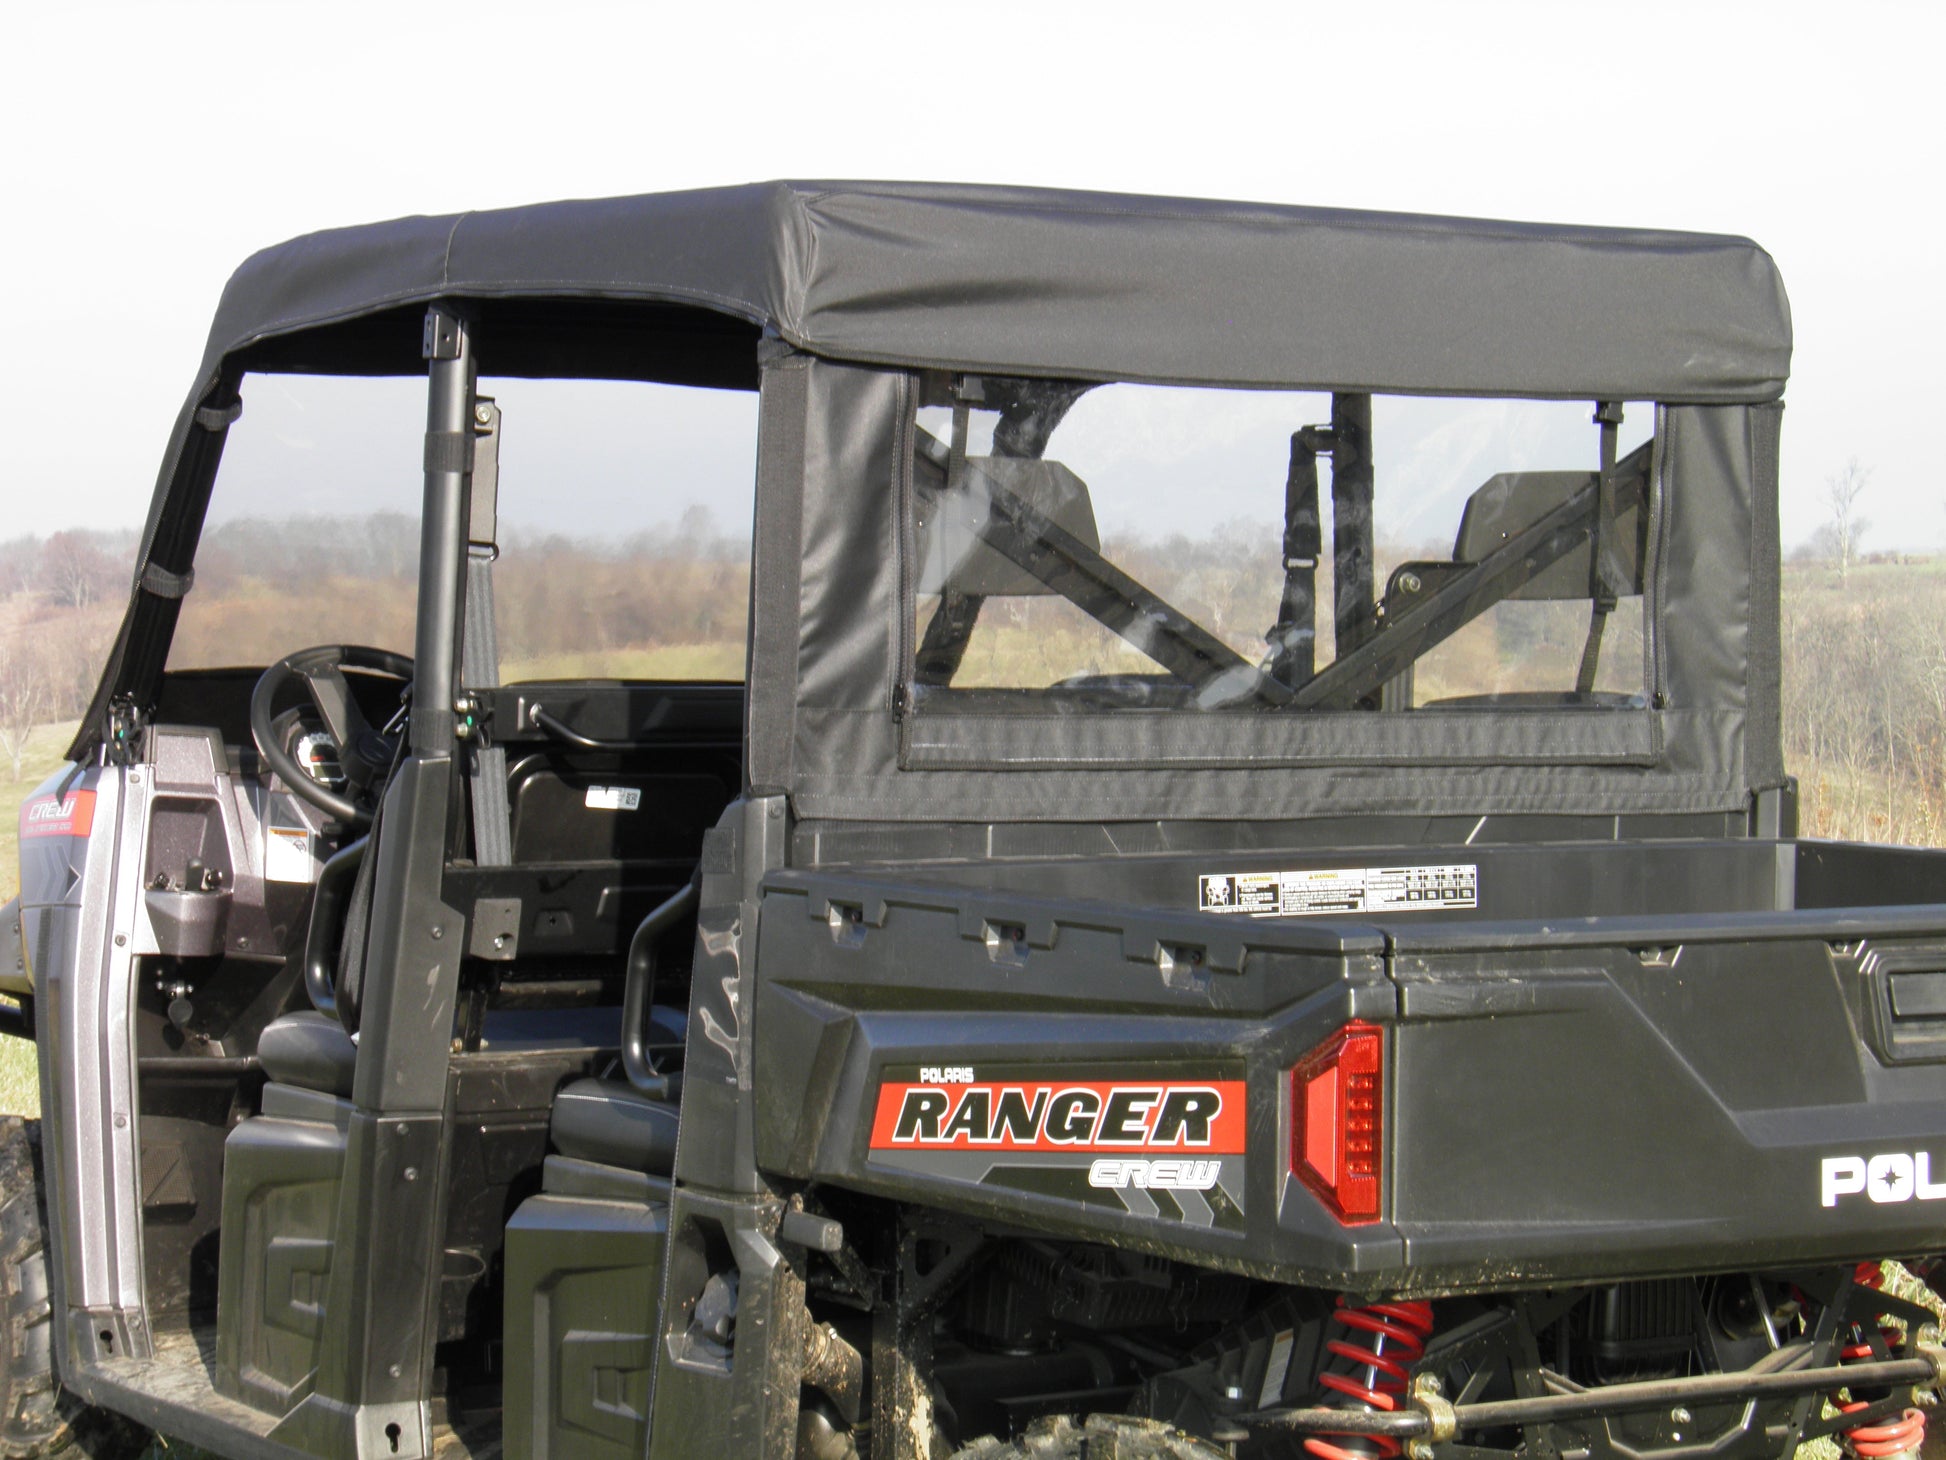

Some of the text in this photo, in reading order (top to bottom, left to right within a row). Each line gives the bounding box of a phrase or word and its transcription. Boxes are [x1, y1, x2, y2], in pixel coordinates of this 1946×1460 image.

[28, 799, 76, 821] CREW
[920, 1067, 974, 1083] POLARIS
[892, 1087, 1222, 1145] RANGER
[1089, 1159, 1221, 1189] CREW
[1822, 1151, 1946, 1207] POL
